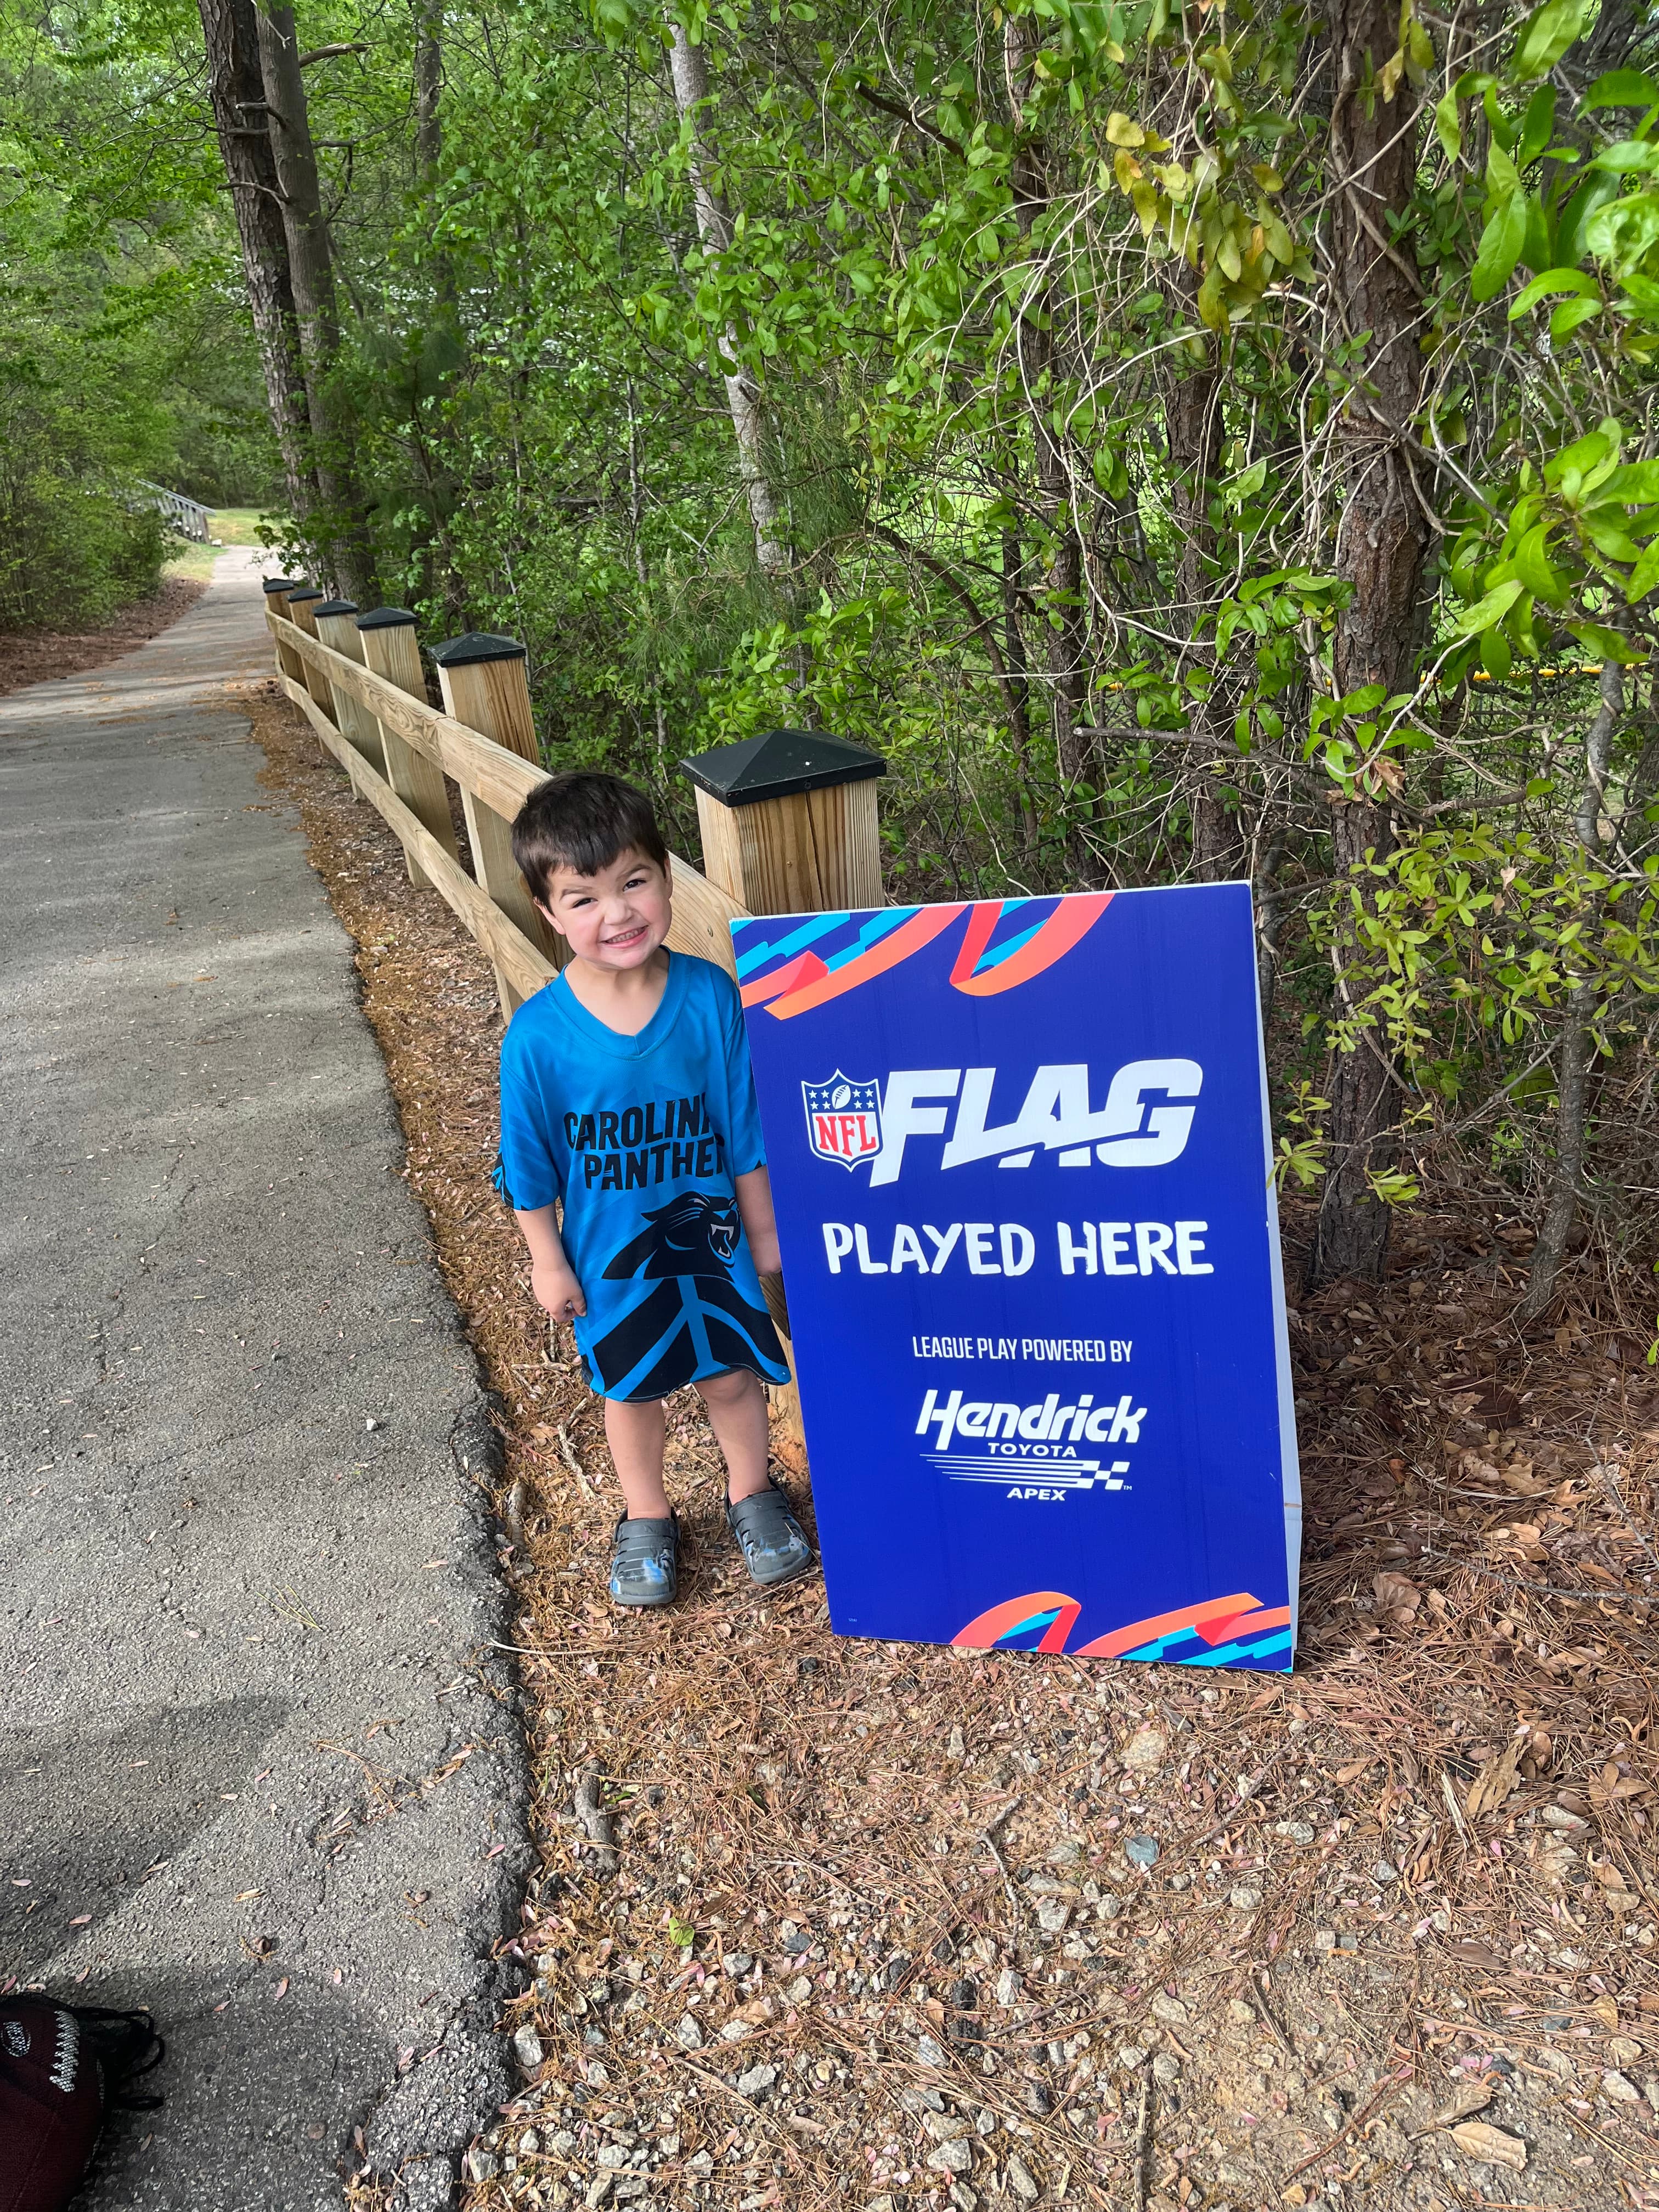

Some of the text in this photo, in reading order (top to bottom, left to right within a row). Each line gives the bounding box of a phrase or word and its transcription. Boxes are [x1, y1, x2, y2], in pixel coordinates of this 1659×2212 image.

[815, 1058, 1203, 1187] NFL FLAG
[822, 1221, 1214, 1277] PLAYED HERE
[912, 1336, 1133, 1362] LEAGUE PLAY POWERED BY
[915, 1389, 1148, 1451] Hendrick
[988, 1442, 1077, 1458] TOYOTA
[1006, 1487, 1067, 1501] APEX
